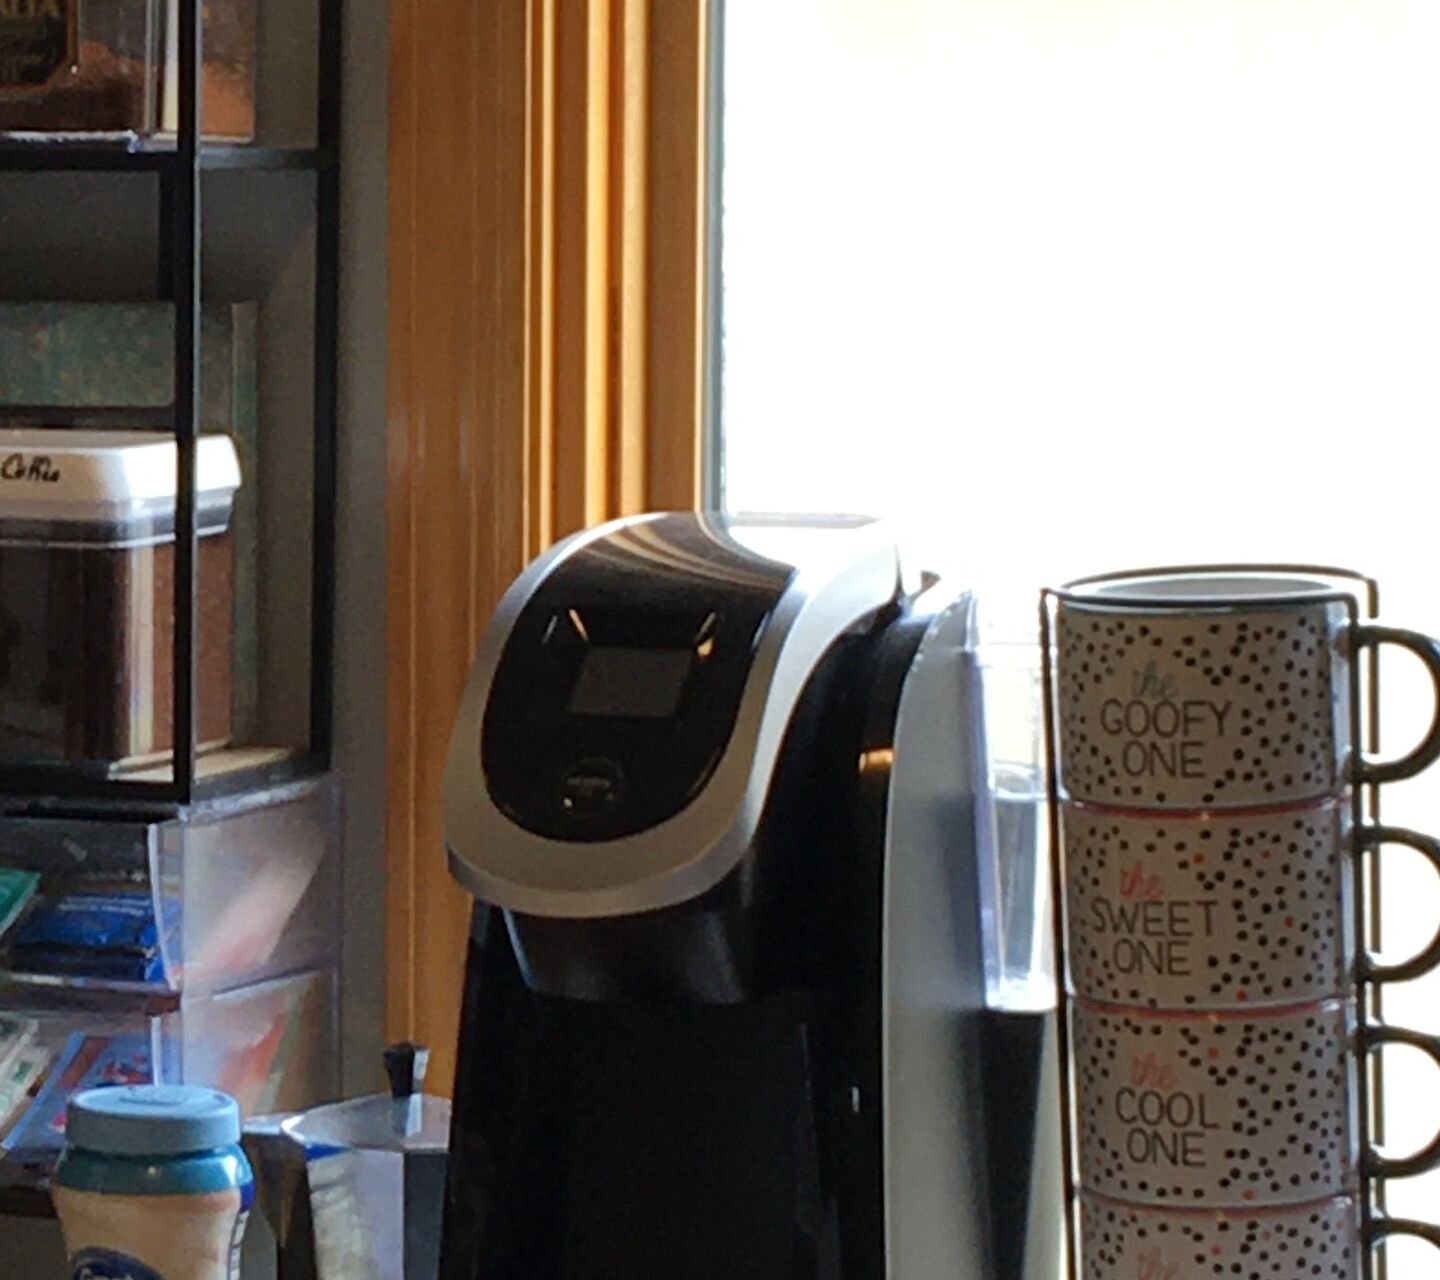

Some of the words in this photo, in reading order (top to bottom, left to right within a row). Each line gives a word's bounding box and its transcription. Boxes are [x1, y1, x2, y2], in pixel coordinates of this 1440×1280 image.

[1132, 660, 1176, 698] the
[1100, 699, 1232, 737] GOOFY
[1122, 741, 1205, 778] ONE
[1120, 861, 1165, 899] the
[1090, 897, 1219, 937] SWEET
[1113, 939, 1192, 976] ONE
[1131, 1052, 1178, 1091] the
[1115, 1087, 1220, 1130] COOL
[1126, 1129, 1208, 1169] ONE
